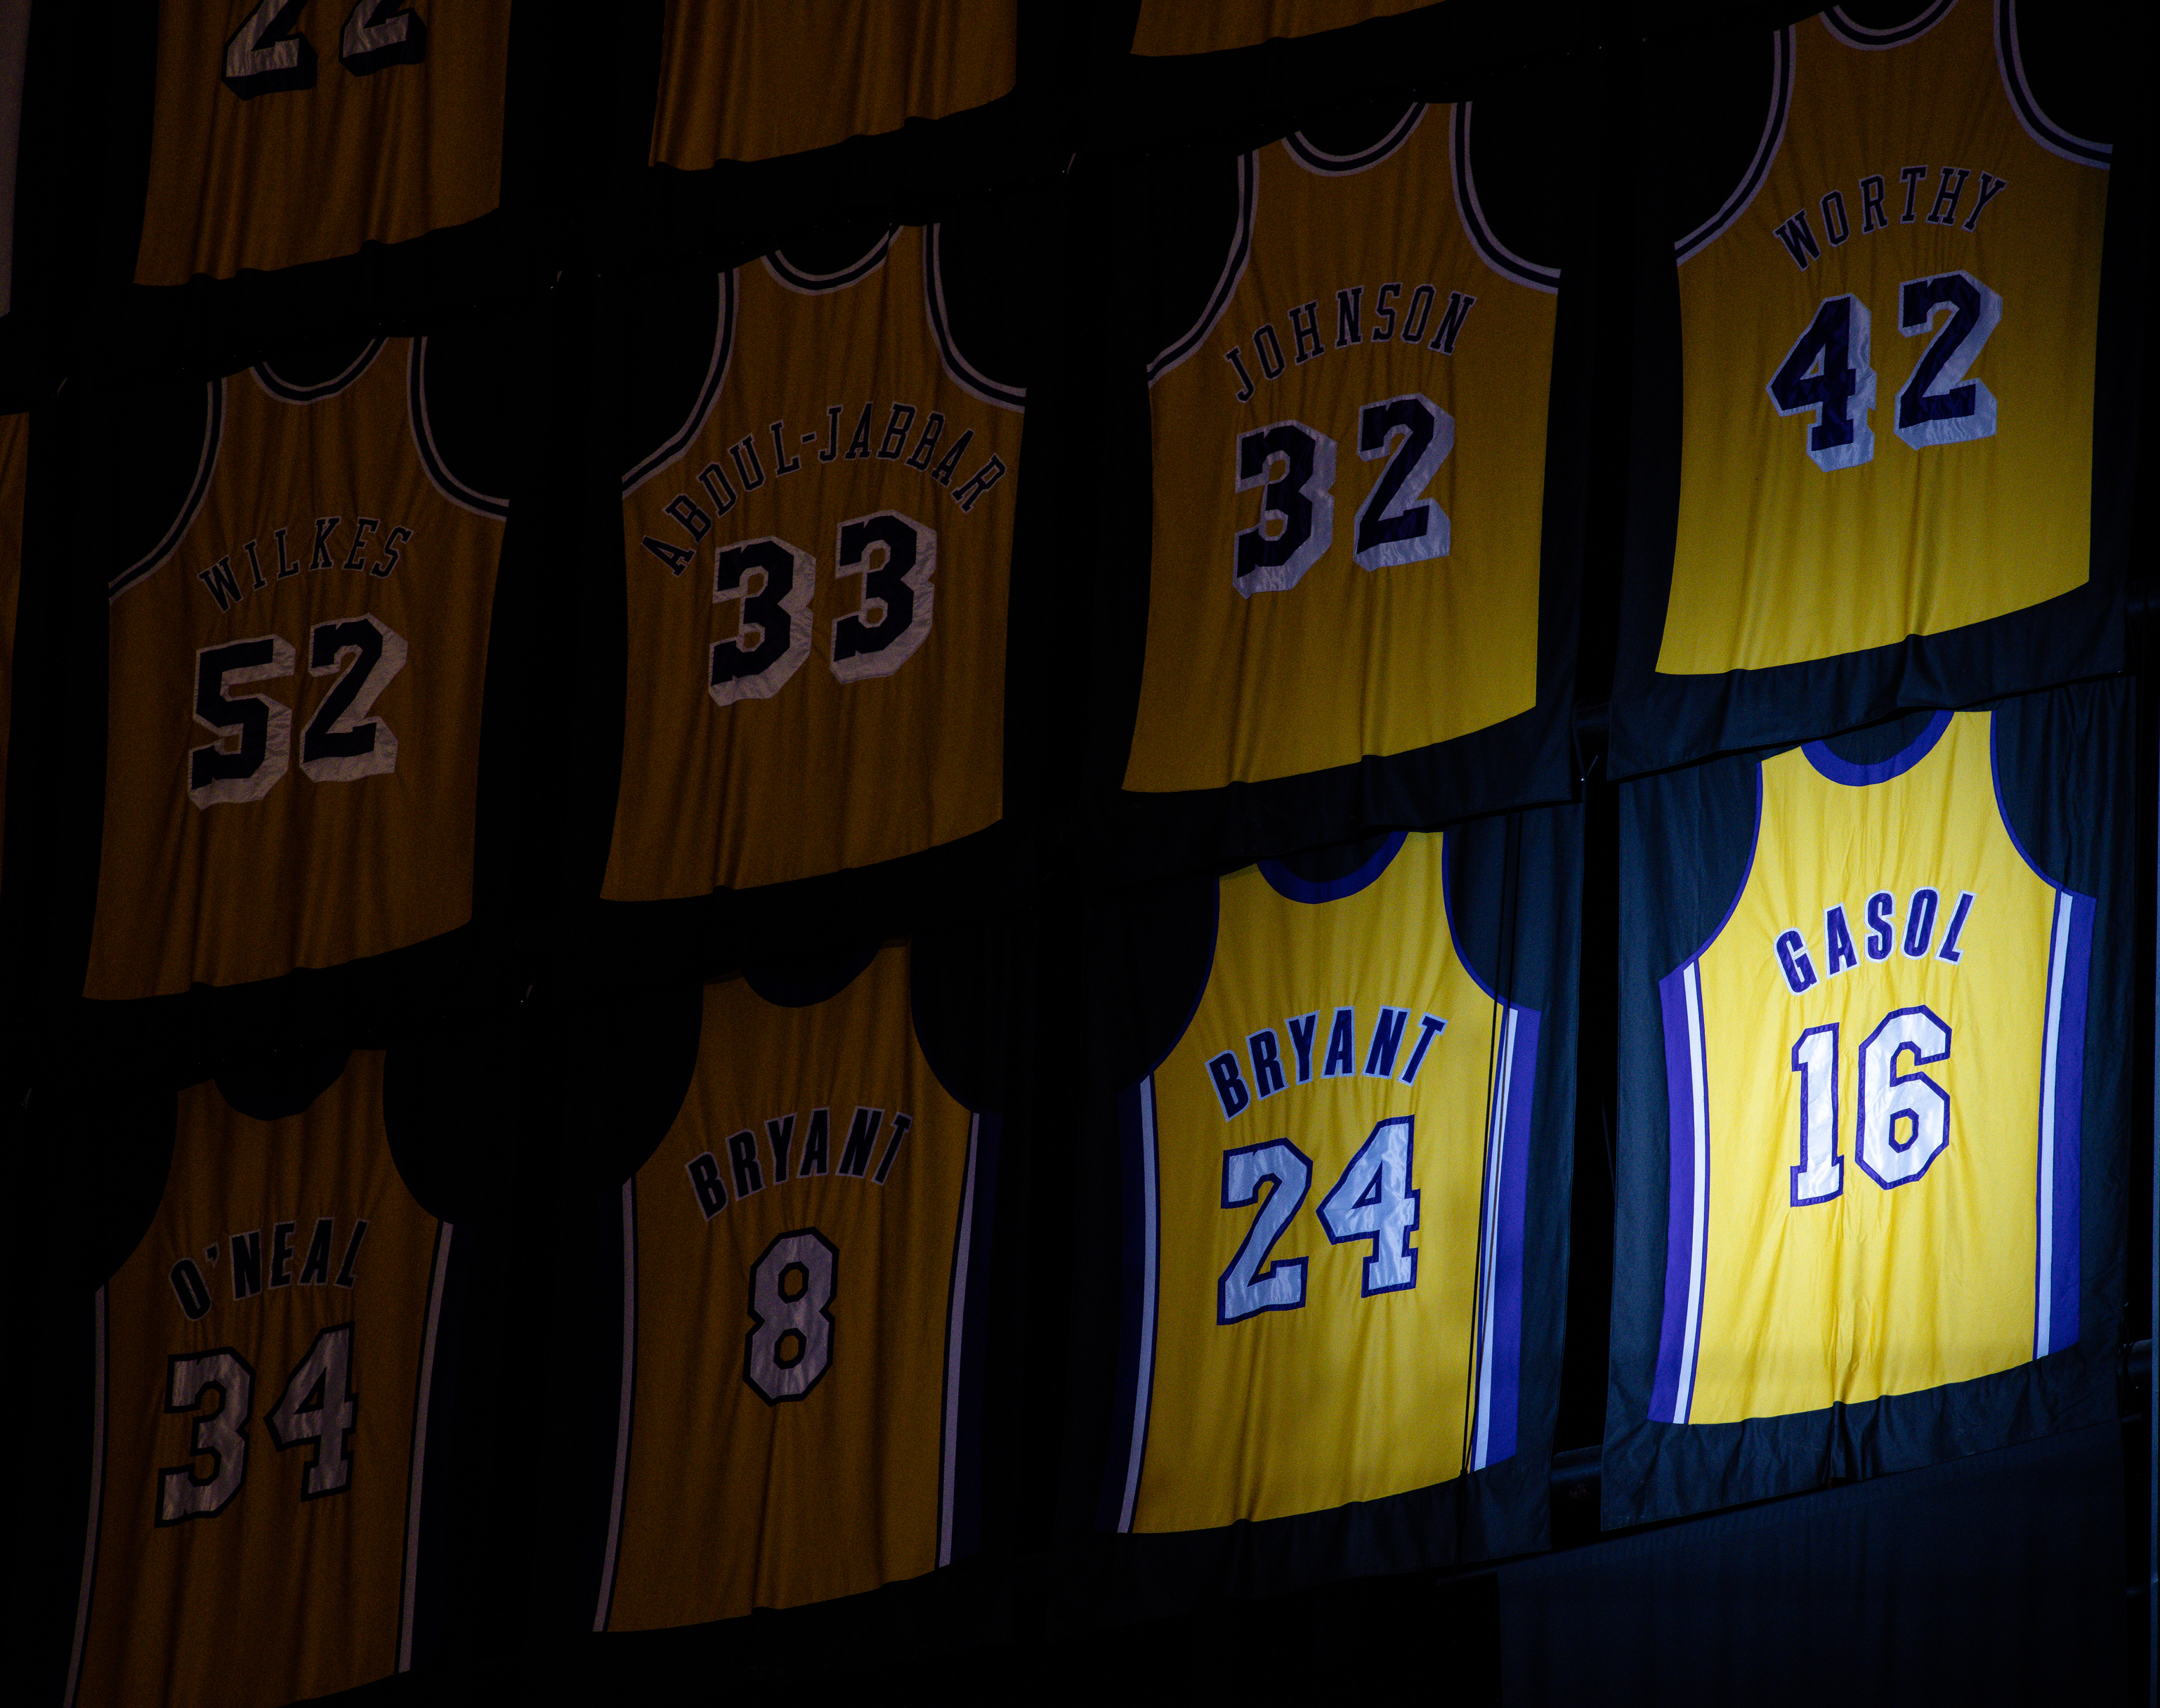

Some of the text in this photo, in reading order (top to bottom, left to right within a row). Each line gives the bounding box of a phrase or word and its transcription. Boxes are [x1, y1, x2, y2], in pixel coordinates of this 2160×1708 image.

[1774, 164, 2008, 272] WORTHY
[1225, 282, 1478, 402] JOHNSON
[1765, 270, 2003, 472] 42
[199, 515, 413, 613] WILKES
[641, 400, 1007, 577] ABDUL-JABBAR
[1232, 393, 1455, 600] 32
[708, 510, 938, 707] 33
[188, 612, 409, 811] 52
[1774, 886, 1977, 995] GASOL
[1205, 1006, 1448, 1122] BRYANT
[1790, 1004, 1952, 1208] 16
[685, 1105, 912, 1222] BRYANT
[1217, 1115, 1420, 1326] 24
[169, 1216, 369, 1321] O'NEAL
[743, 1227, 839, 1407] 8
[155, 1322, 359, 1528] 34
